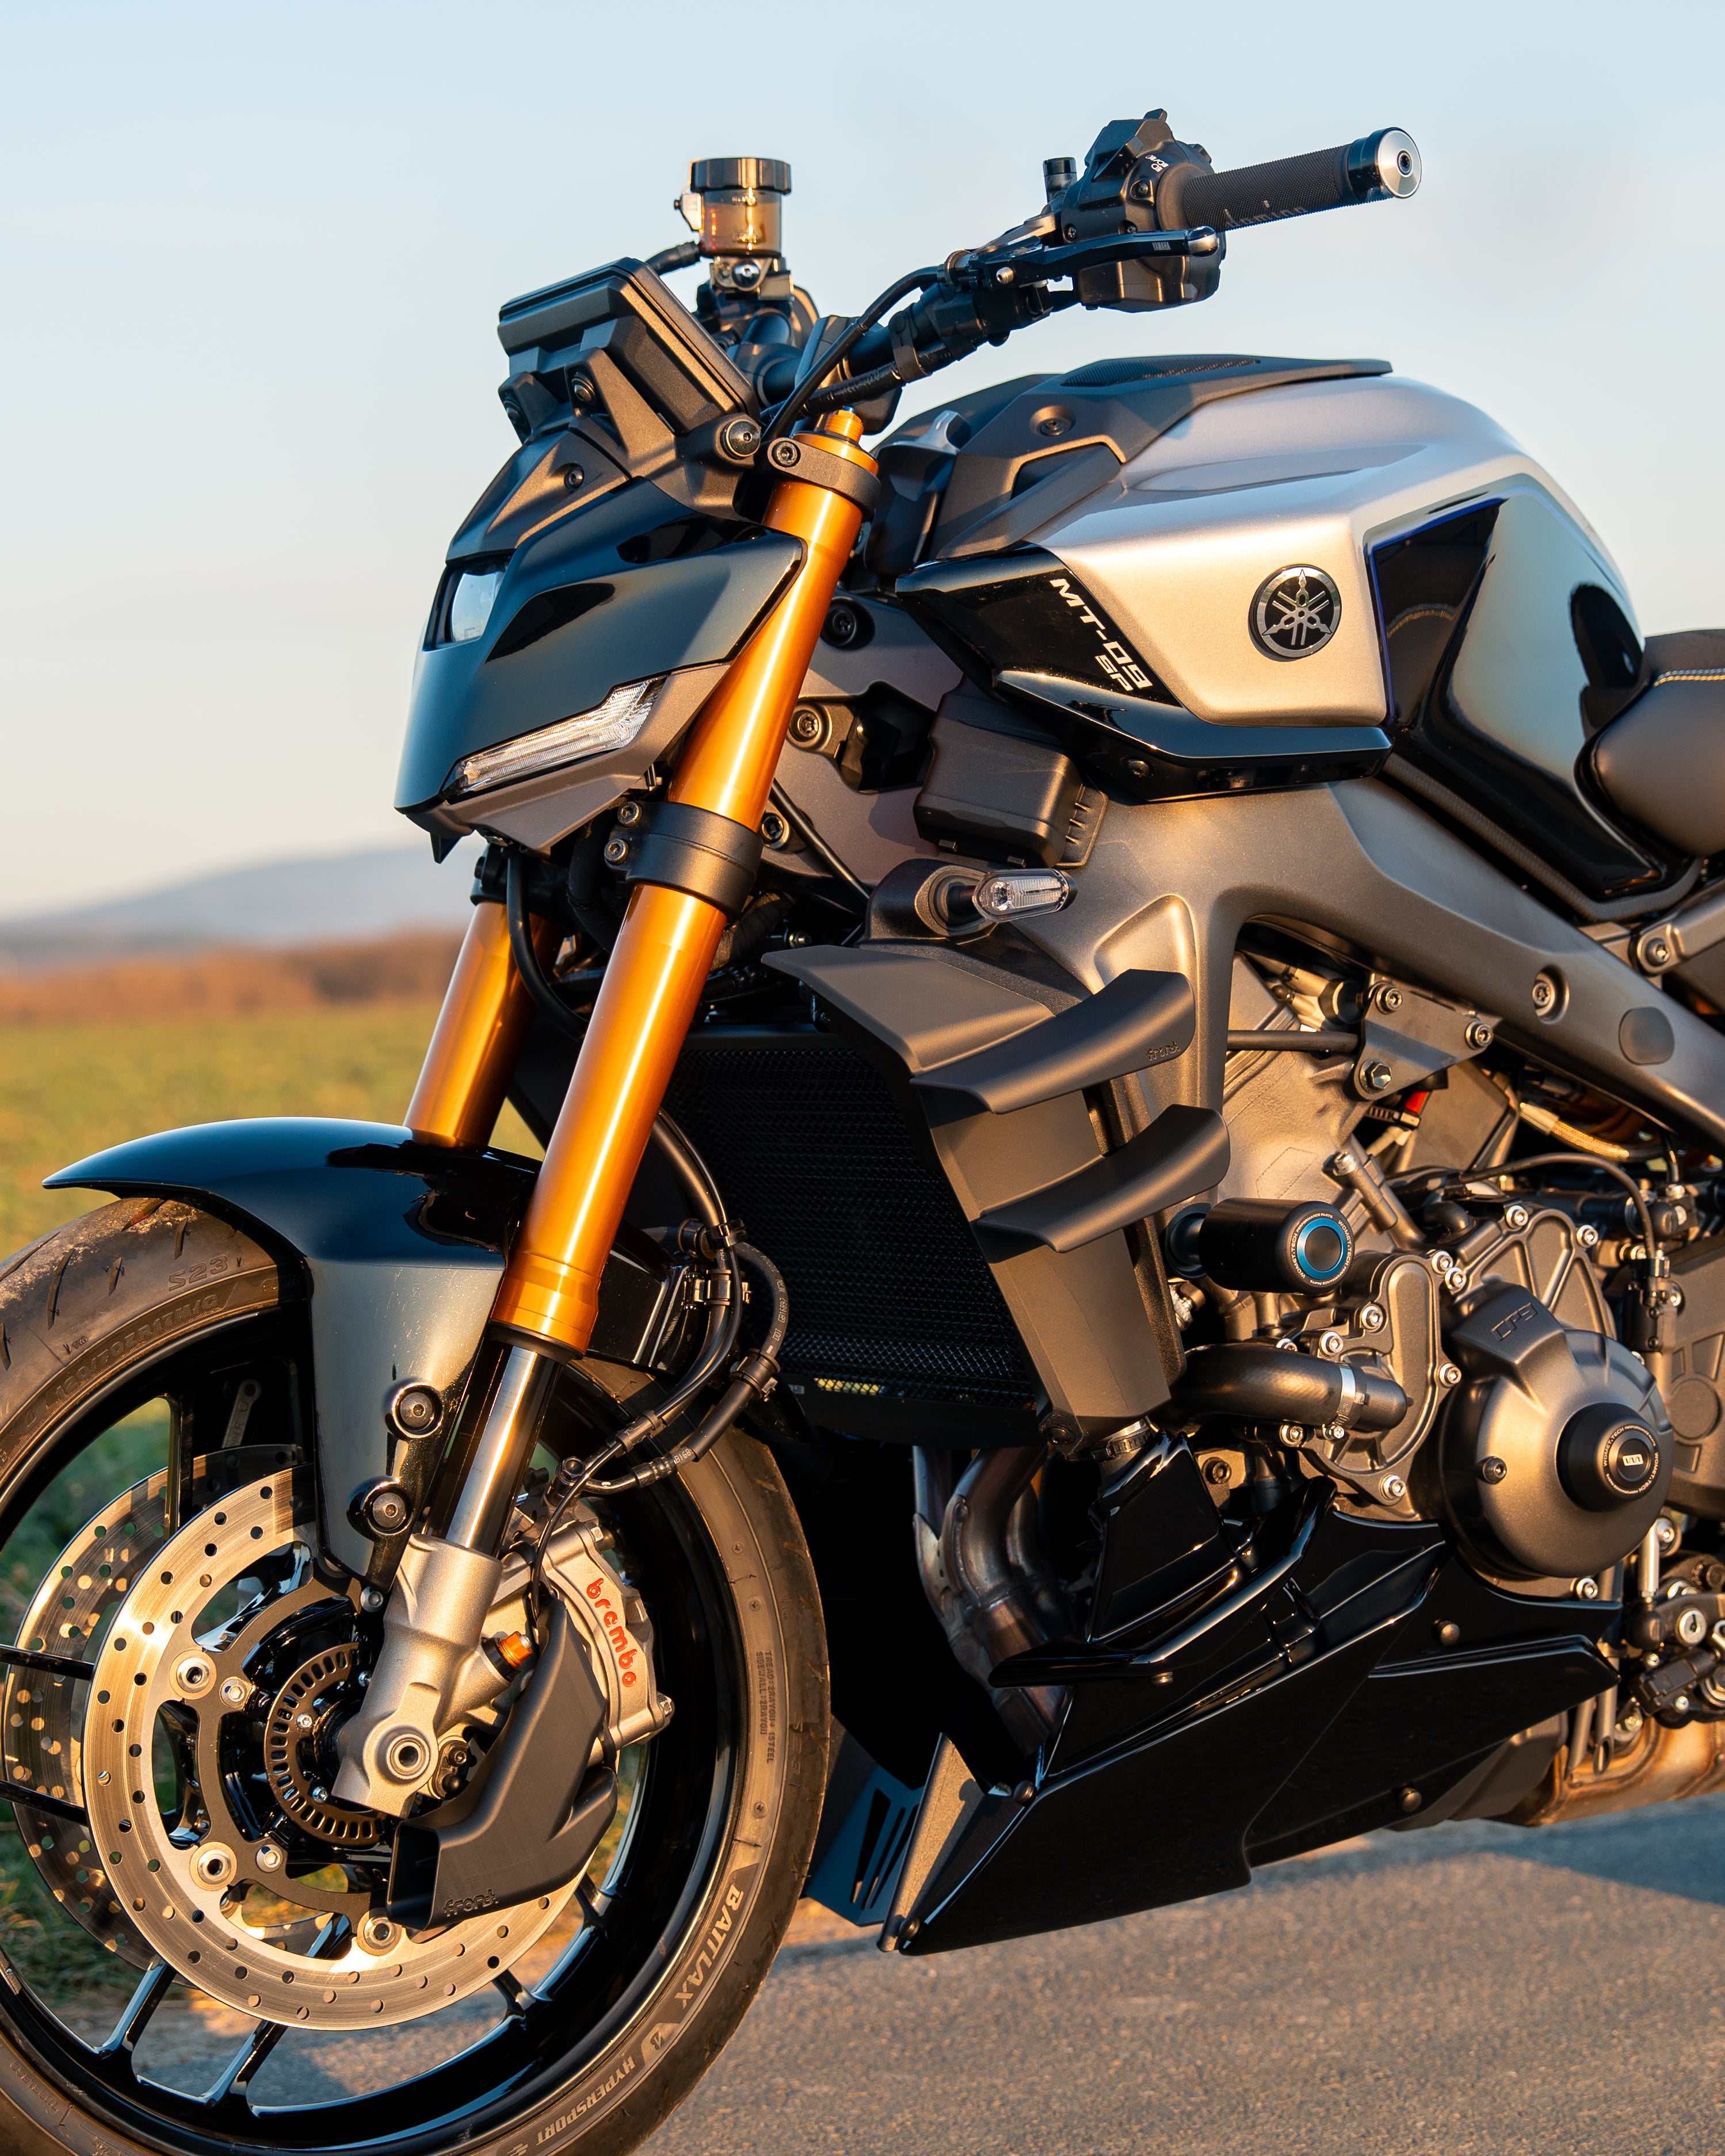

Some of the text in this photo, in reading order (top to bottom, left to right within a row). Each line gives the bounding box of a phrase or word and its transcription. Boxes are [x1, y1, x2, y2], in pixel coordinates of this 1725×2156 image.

[1049, 579, 1152, 689] MT-09
[1095, 655, 1134, 691] SP
[168, 1255, 229, 1292] S23
[1491, 1302, 1538, 1341] CP3
[586, 1578, 638, 1687] brembo
[674, 1884, 744, 2009] BATTLAX
[10, 2061, 60, 2112] TUBELESS
[536, 2056, 636, 2146] HYPERSPORT
